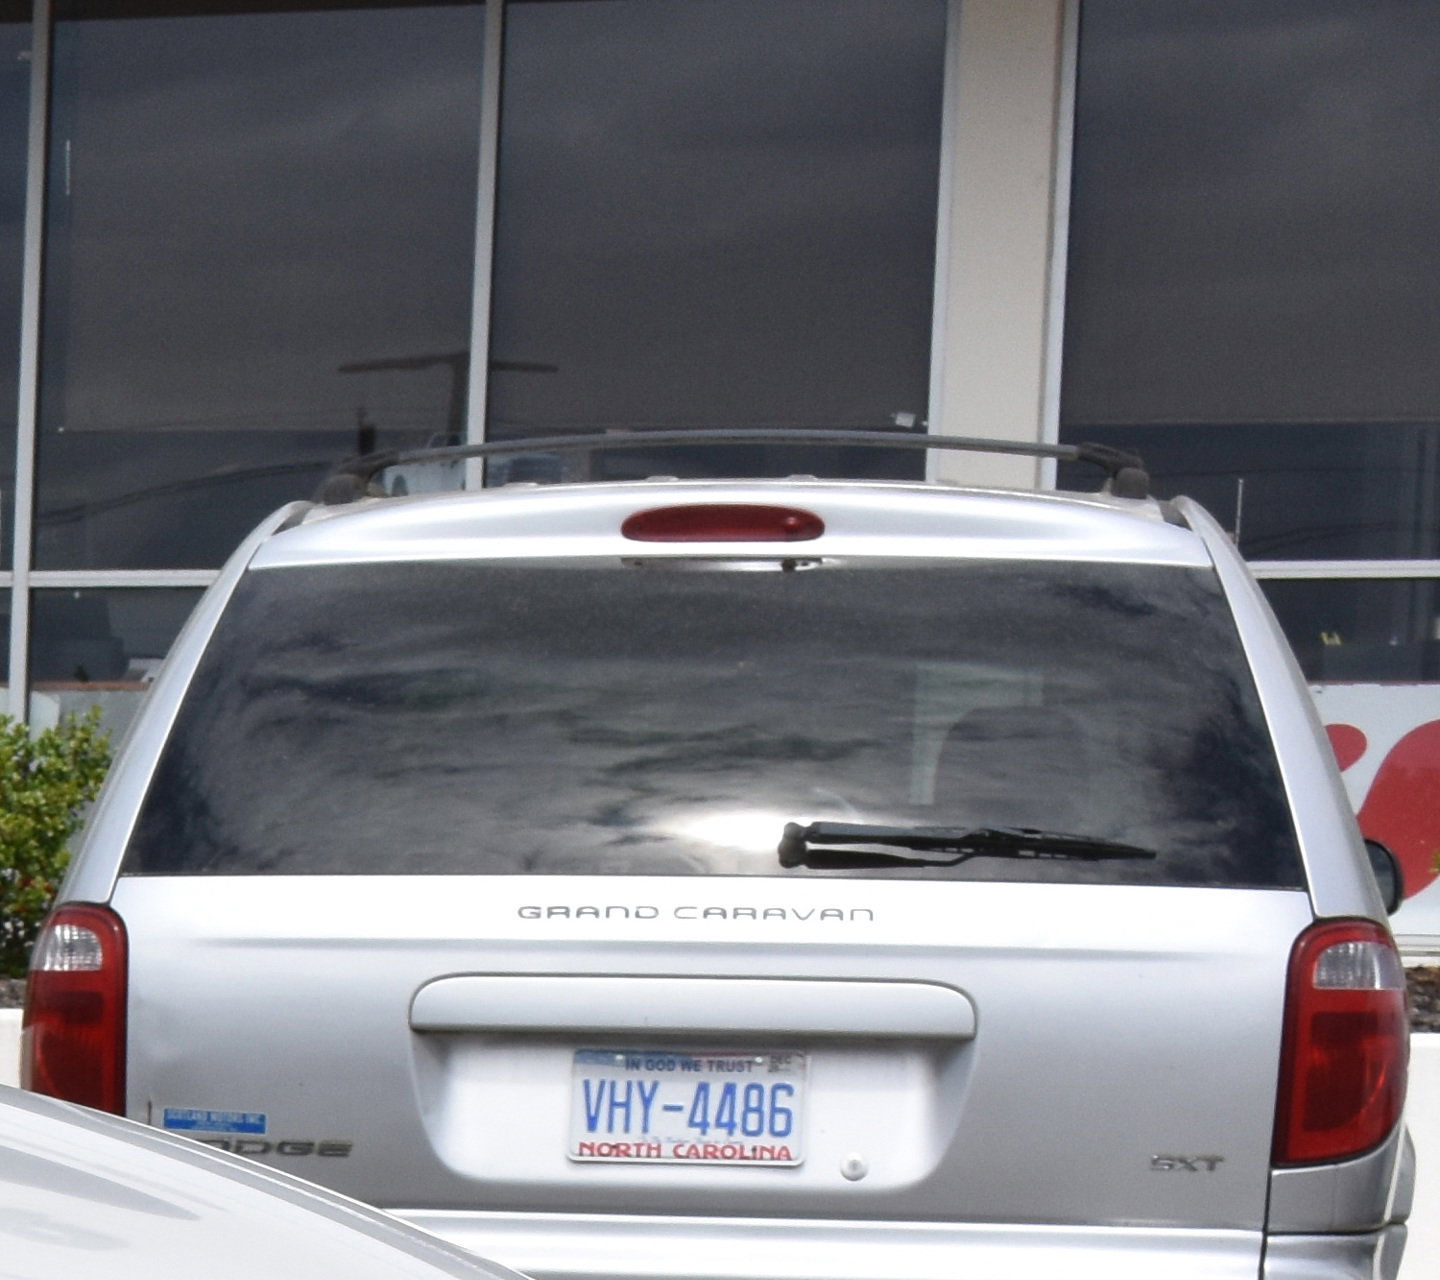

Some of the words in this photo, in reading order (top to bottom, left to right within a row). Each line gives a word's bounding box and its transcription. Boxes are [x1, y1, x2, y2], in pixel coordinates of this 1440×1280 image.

[517, 905, 660, 920] GRAND
[673, 906, 874, 921] CARAVAN
[625, 1059, 641, 1071] IN
[645, 1059, 676, 1072] GOD
[681, 1060, 702, 1072] WE
[708, 1060, 753, 1073] TRUST
[582, 1079, 795, 1138] VHY-4486
[579, 1142, 662, 1158] NORTH
[672, 1143, 793, 1161] CAROLINA
[1150, 1153, 1225, 1172] SXT
